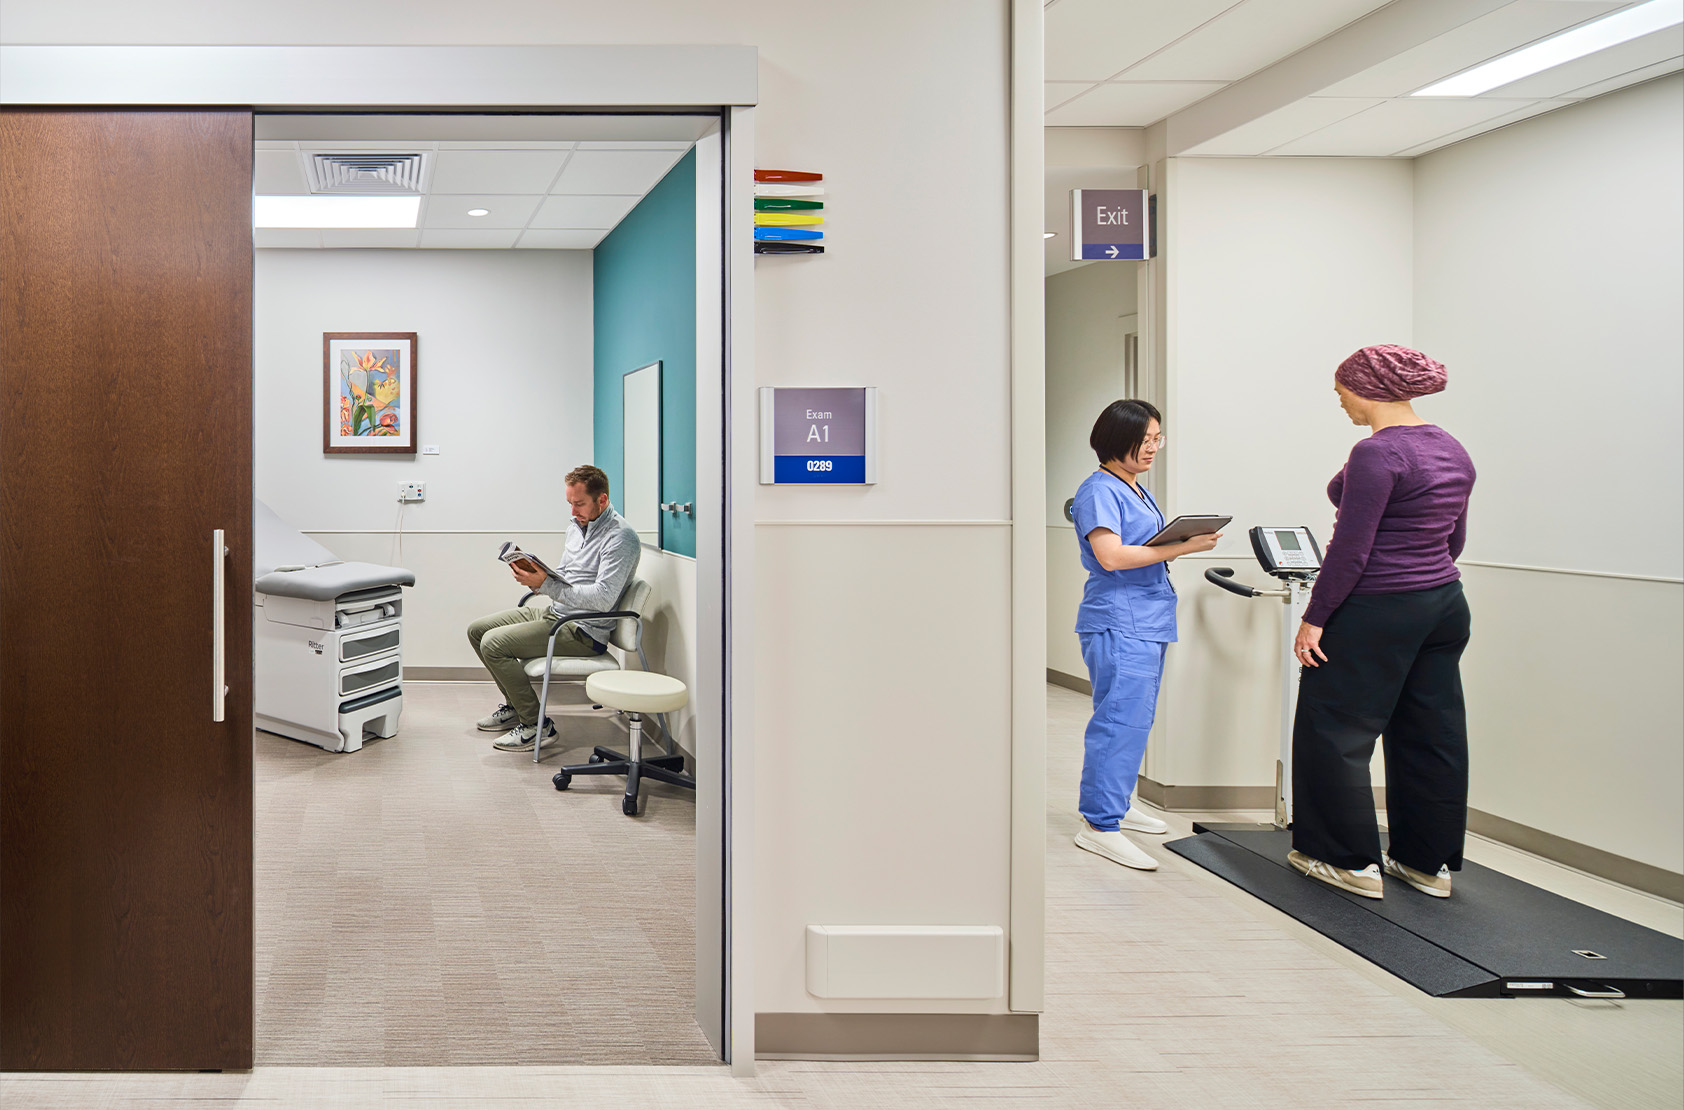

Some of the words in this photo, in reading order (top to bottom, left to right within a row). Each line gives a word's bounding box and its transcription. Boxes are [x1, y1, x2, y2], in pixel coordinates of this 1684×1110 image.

[1096, 206, 1129, 225] Exit
[806, 409, 832, 420] Exam
[806, 424, 830, 443] A1
[806, 460, 833, 472] 0289
